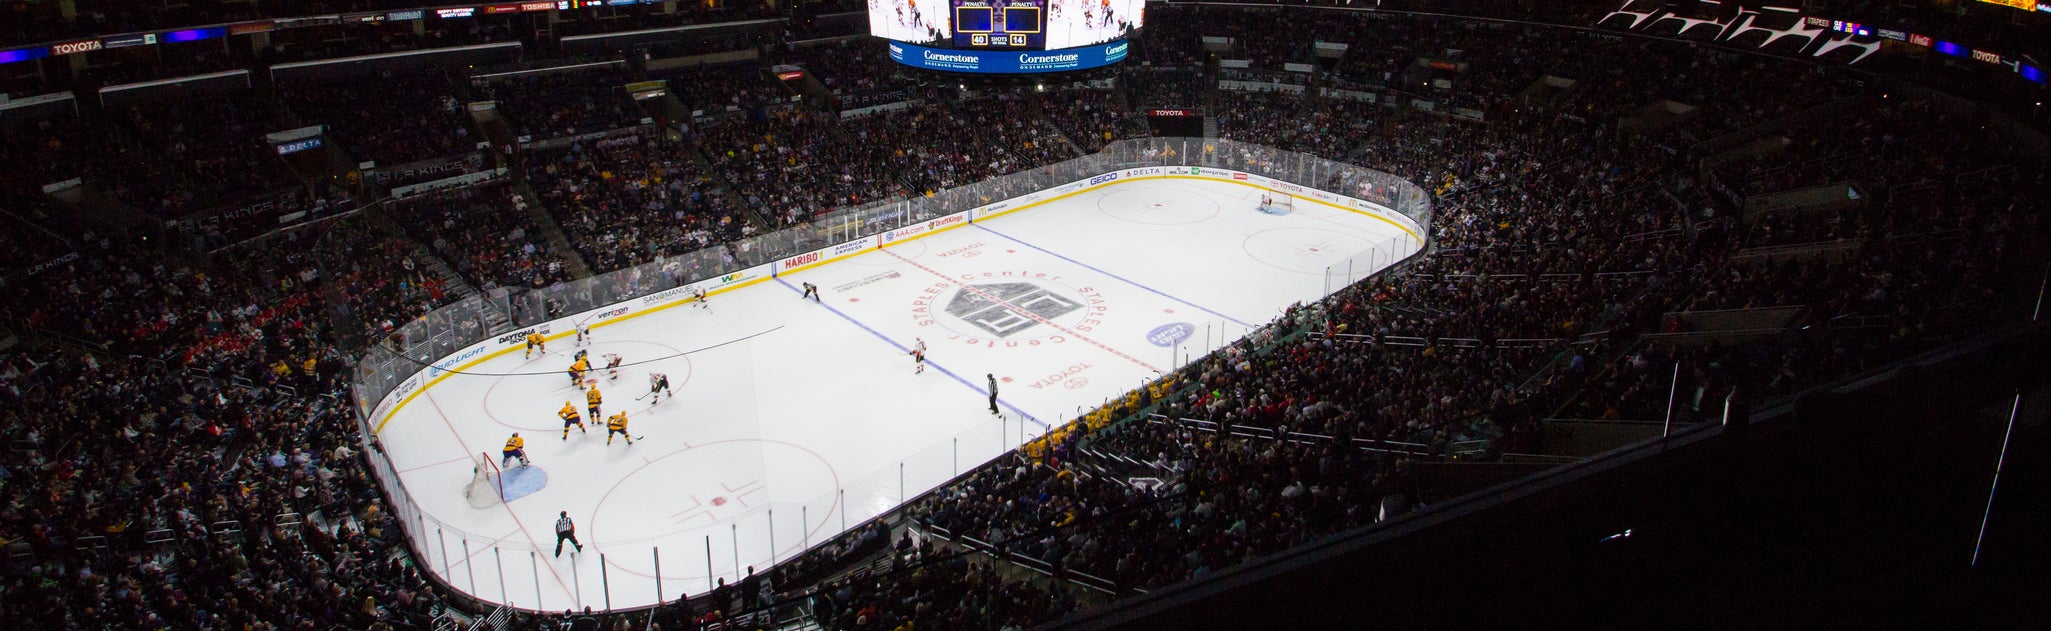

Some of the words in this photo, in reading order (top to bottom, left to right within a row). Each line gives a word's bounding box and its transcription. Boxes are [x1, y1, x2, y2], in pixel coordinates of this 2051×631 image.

[521, 2, 557, 11] TOSHIBA
[1807, 16, 1830, 28] STAPLES
[974, 36, 985, 44] 40
[1013, 36, 1024, 44] 14
[53, 41, 102, 55] TOYOTA
[924, 50, 979, 63] Cornerstone
[1019, 53, 1079, 64] Cornerstone
[1972, 50, 2001, 65] TOYOTA
[288, 139, 322, 152] DELTA
[419, 161, 464, 177] KINGS
[1132, 167, 1160, 177] DELTA
[1089, 172, 1118, 187] GEICO
[1280, 182, 1304, 194] TOYOTA
[222, 201, 274, 222] KINGS
[934, 214, 963, 228] DraftKings
[895, 224, 925, 238] AAA.com
[834, 244, 863, 256] EXPRESS
[835, 238, 868, 251] AMERICAN
[936, 241, 987, 258] TOYOTA
[45, 251, 80, 269] KINGS
[785, 252, 819, 269] HARIBO
[961, 270, 1063, 282] Center
[643, 292, 659, 305] SAN
[664, 284, 694, 298] MANUEL
[912, 281, 951, 328] STAPLES
[1077, 286, 1109, 333] STAPLES
[597, 305, 630, 321] verizon
[498, 328, 536, 344] DAYTONA
[510, 336, 526, 345] 500
[947, 335, 1068, 349] Center
[429, 360, 455, 378] BUD
[455, 345, 487, 365] LIGHT
[1028, 362, 1093, 389] TOYOTA
[559, 622, 573, 631] 77
